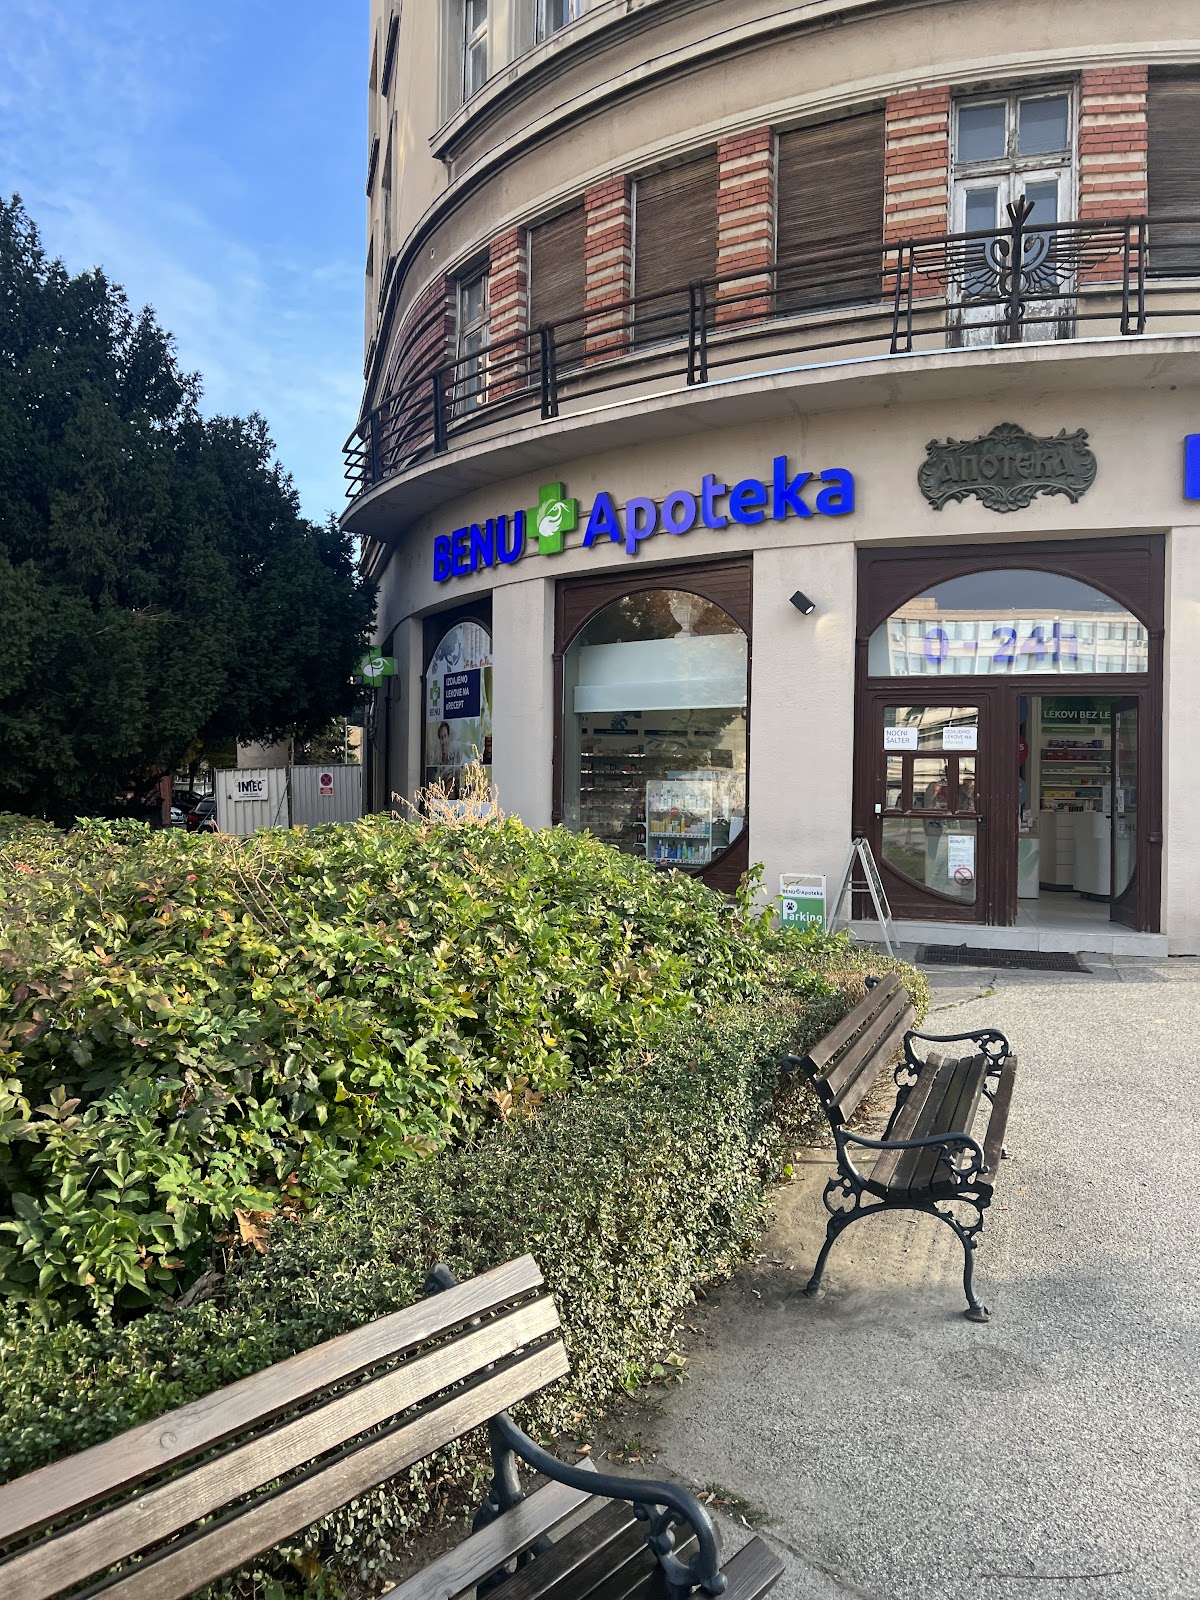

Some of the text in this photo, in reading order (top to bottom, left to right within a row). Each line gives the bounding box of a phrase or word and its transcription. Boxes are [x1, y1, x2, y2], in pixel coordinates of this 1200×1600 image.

[940, 451, 1075, 483] АПОТЕКА
[433, 455, 855, 582] BENU Apoteka
[924, 628, 948, 663] 0
[993, 623, 1078, 662] 24h
[463, 687, 470, 696] NA
[429, 706, 441, 717] BENU
[1043, 710, 1078, 718] LEKOVI
[1080, 710, 1098, 718] BEZ
[238, 779, 263, 792] INTEC
[782, 899, 822, 924] Parking
